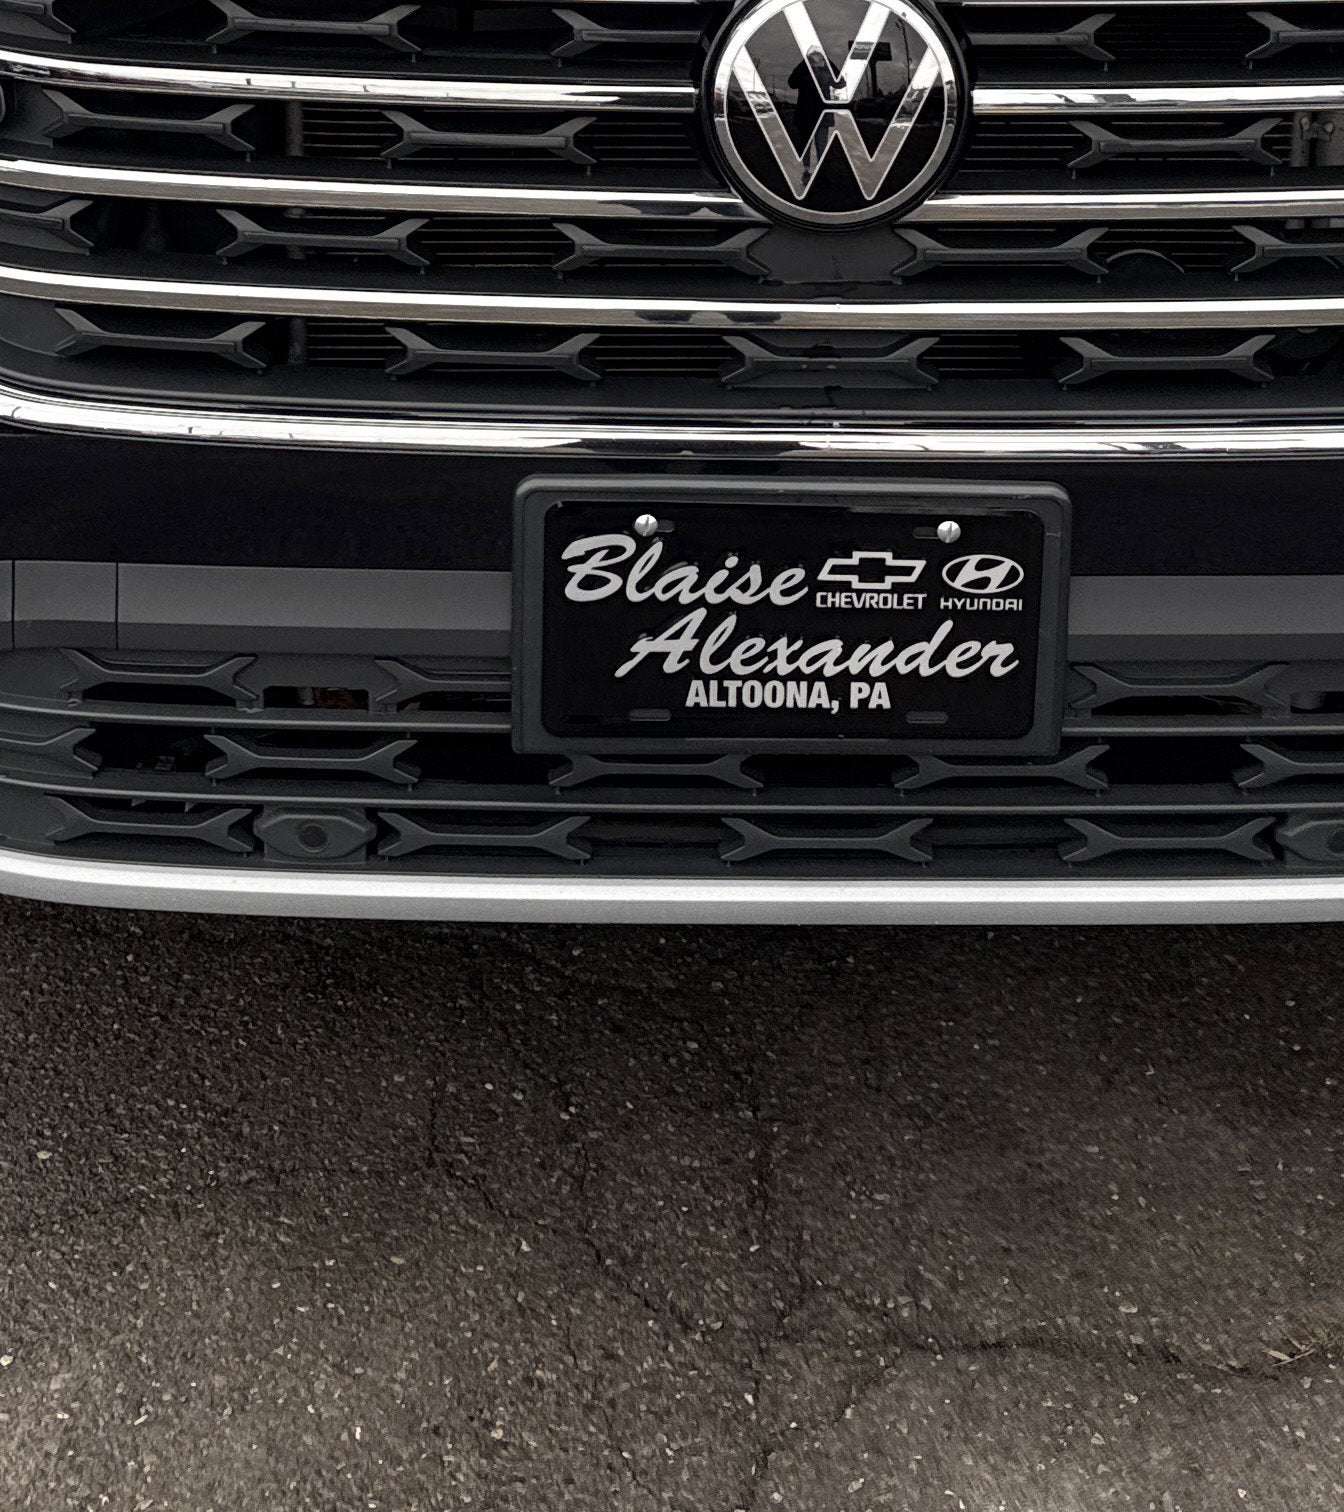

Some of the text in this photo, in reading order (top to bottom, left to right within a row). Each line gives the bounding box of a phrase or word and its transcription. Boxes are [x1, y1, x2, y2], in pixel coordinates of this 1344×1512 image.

[561, 534, 808, 606] Blaise
[815, 591, 928, 610] CHEVROLET
[940, 597, 1024, 611] HYUNDAI
[614, 607, 1020, 678] Alexander
[685, 679, 892, 715] ALTOONA, PA
